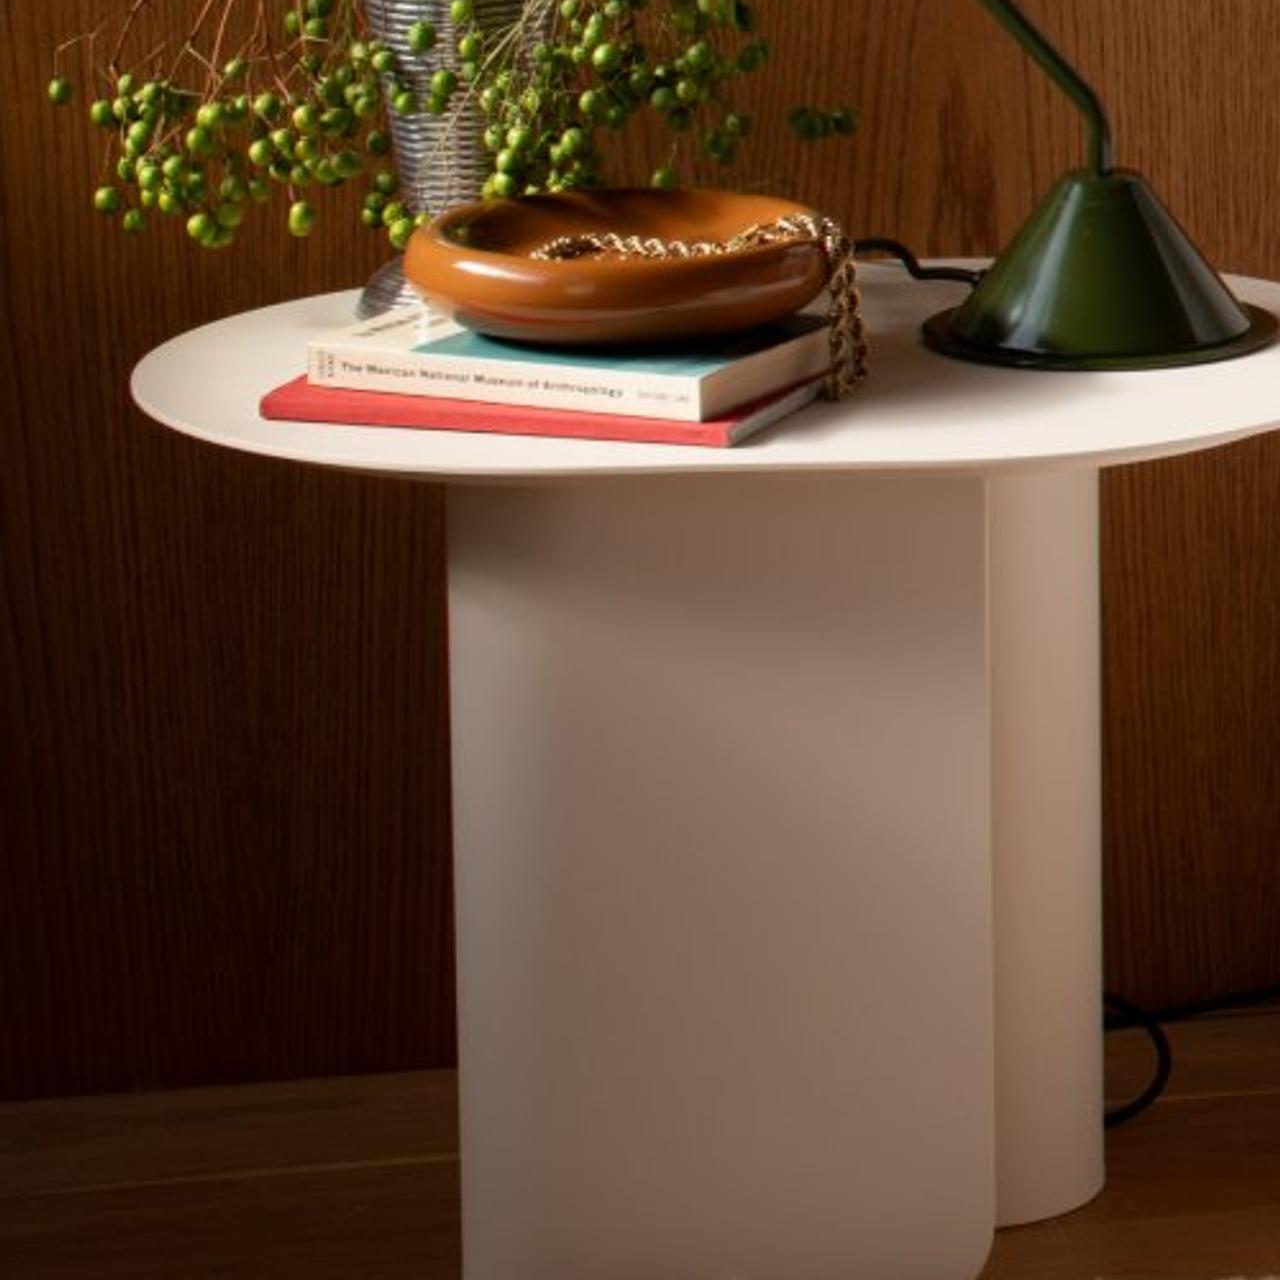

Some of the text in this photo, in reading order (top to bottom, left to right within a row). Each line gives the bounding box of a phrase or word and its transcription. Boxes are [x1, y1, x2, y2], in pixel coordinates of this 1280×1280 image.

[341, 361, 363, 372] The
[366, 363, 416, 377] Mexican
[420, 368, 470, 383] National
[474, 373, 524, 387] Museum
[527, 379, 539, 389] of
